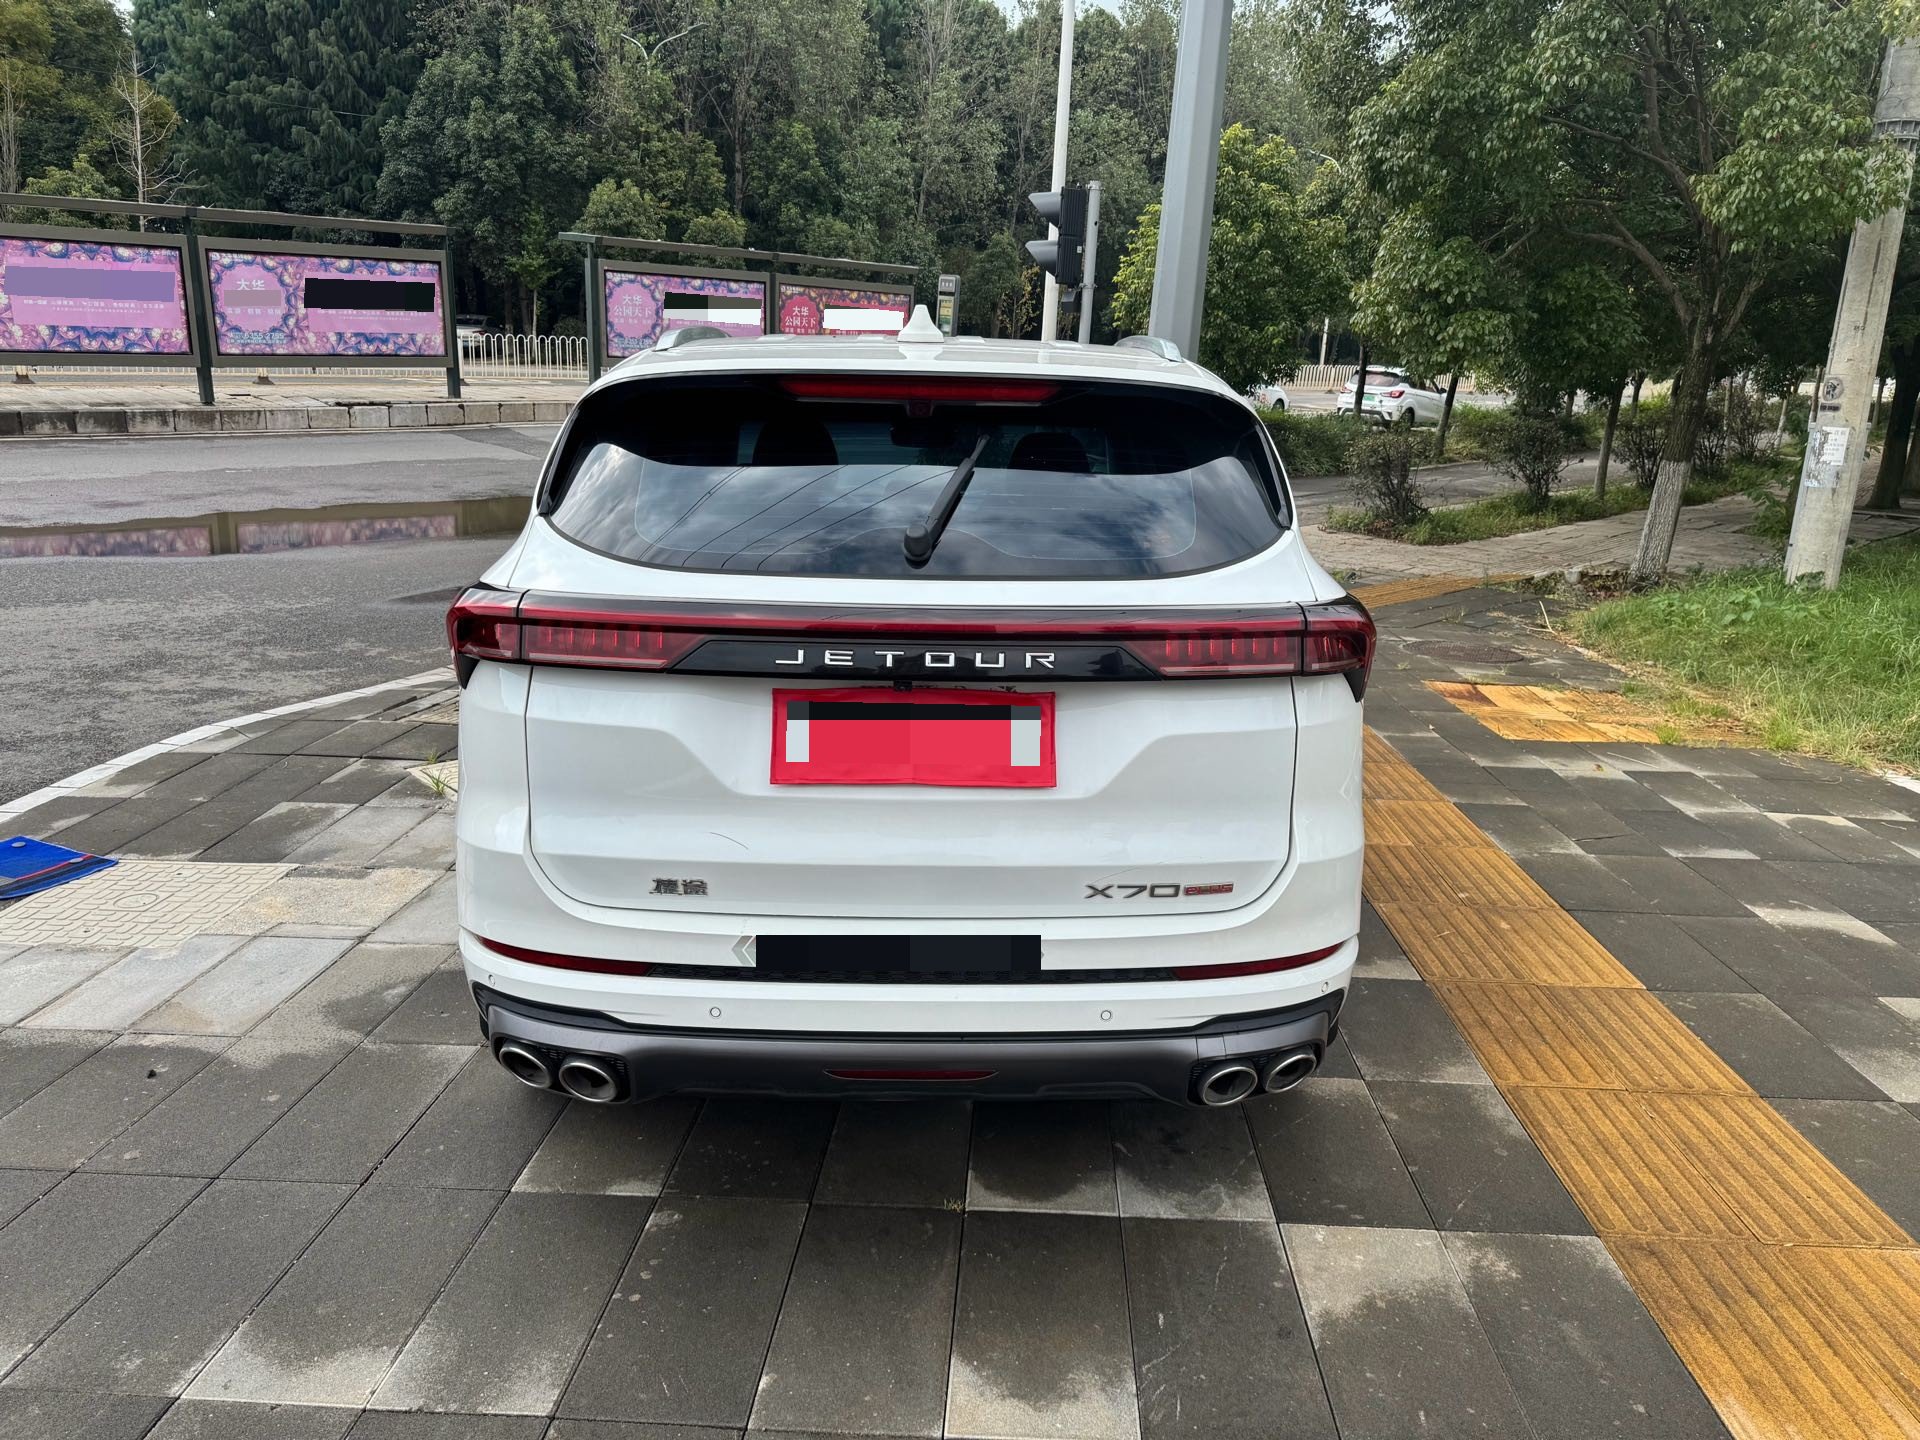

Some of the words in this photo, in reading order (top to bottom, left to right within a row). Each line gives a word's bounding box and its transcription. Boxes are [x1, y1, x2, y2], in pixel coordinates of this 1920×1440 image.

[236, 278, 265, 290] 大华
[622, 295, 644, 305] 大华
[613, 305, 652, 318] 公园天下
[792, 306, 809, 316] 大华
[785, 316, 816, 327] 公园天下
[775, 649, 1056, 669] JETOUR
[1084, 883, 1181, 899] X70
